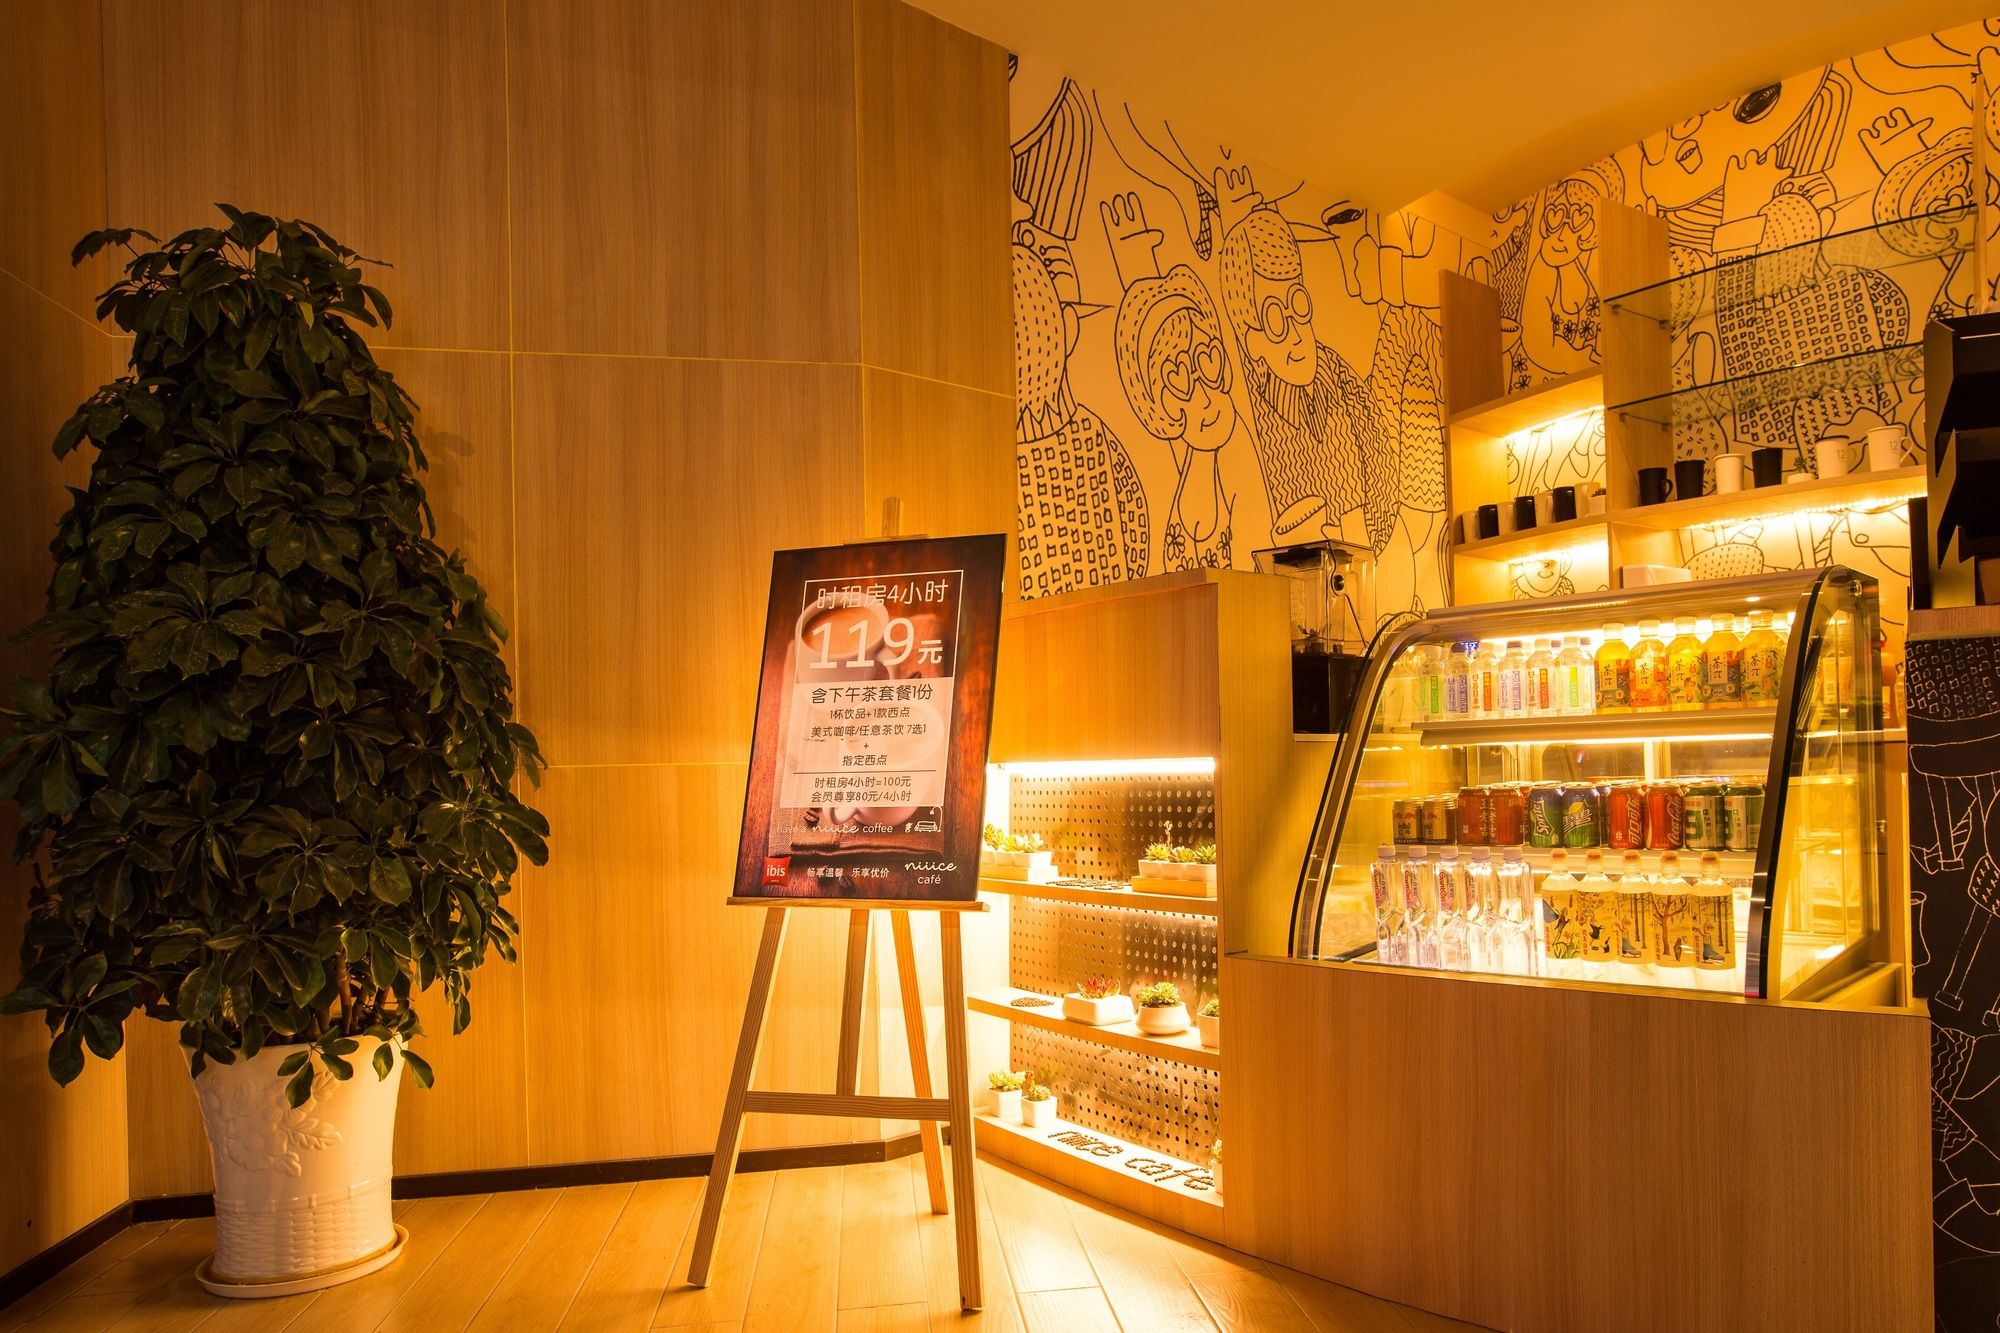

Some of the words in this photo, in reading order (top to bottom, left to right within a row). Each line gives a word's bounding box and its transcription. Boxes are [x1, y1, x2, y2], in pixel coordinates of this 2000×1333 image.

[816, 578, 949, 610] 时租房4小时
[811, 683, 933, 704] 含下午茶套餐1份
[830, 707, 911, 719] 1杯饮品+1款西点
[811, 724, 904, 738] 美式咖啡/任意茶饮
[842, 754, 888, 767] 指定西点
[814, 775, 912, 789] 时租房4小时=100元
[811, 790, 912, 803] 会员尊享80元/4小时
[863, 822, 894, 833] coffee
[766, 864, 786, 877] ibis
[851, 867, 890, 878] 乐享优价
[904, 861, 957, 871] niiice
[917, 874, 941, 884] café
